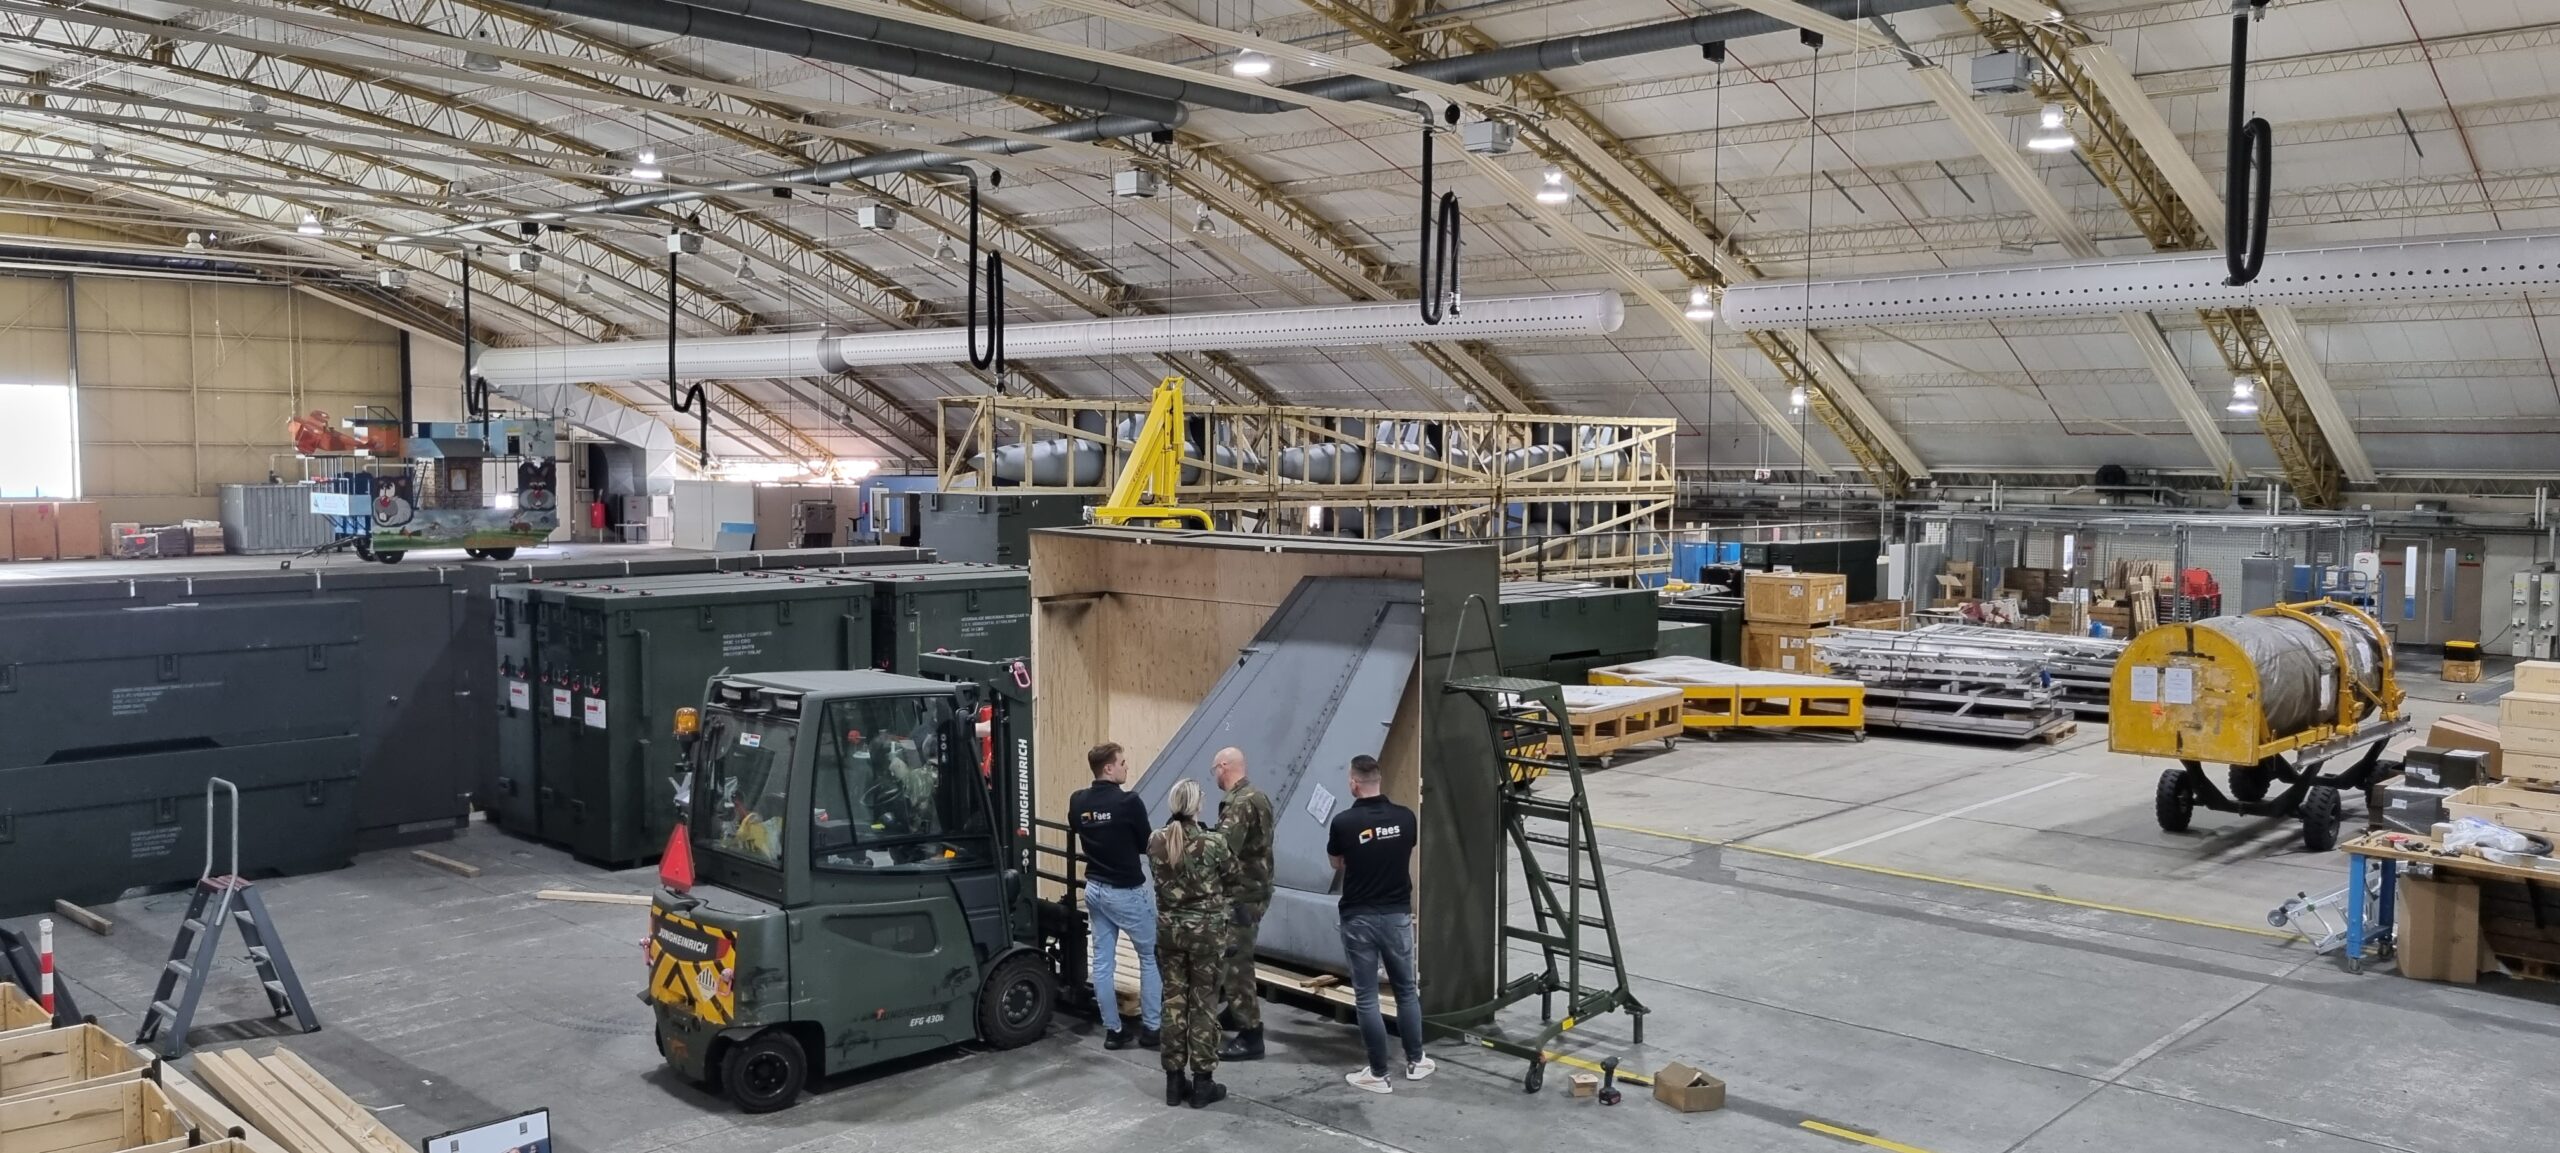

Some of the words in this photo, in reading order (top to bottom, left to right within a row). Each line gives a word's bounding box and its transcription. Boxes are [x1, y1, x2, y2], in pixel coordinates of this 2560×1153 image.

[1018, 738, 1031, 836] JUNGHEINRICH
[1093, 811, 1111, 821] Faes
[1375, 825, 1401, 837] Faes
[658, 927, 709, 955] JUNGHEINRICH
[909, 1016, 925, 1027] EFG
